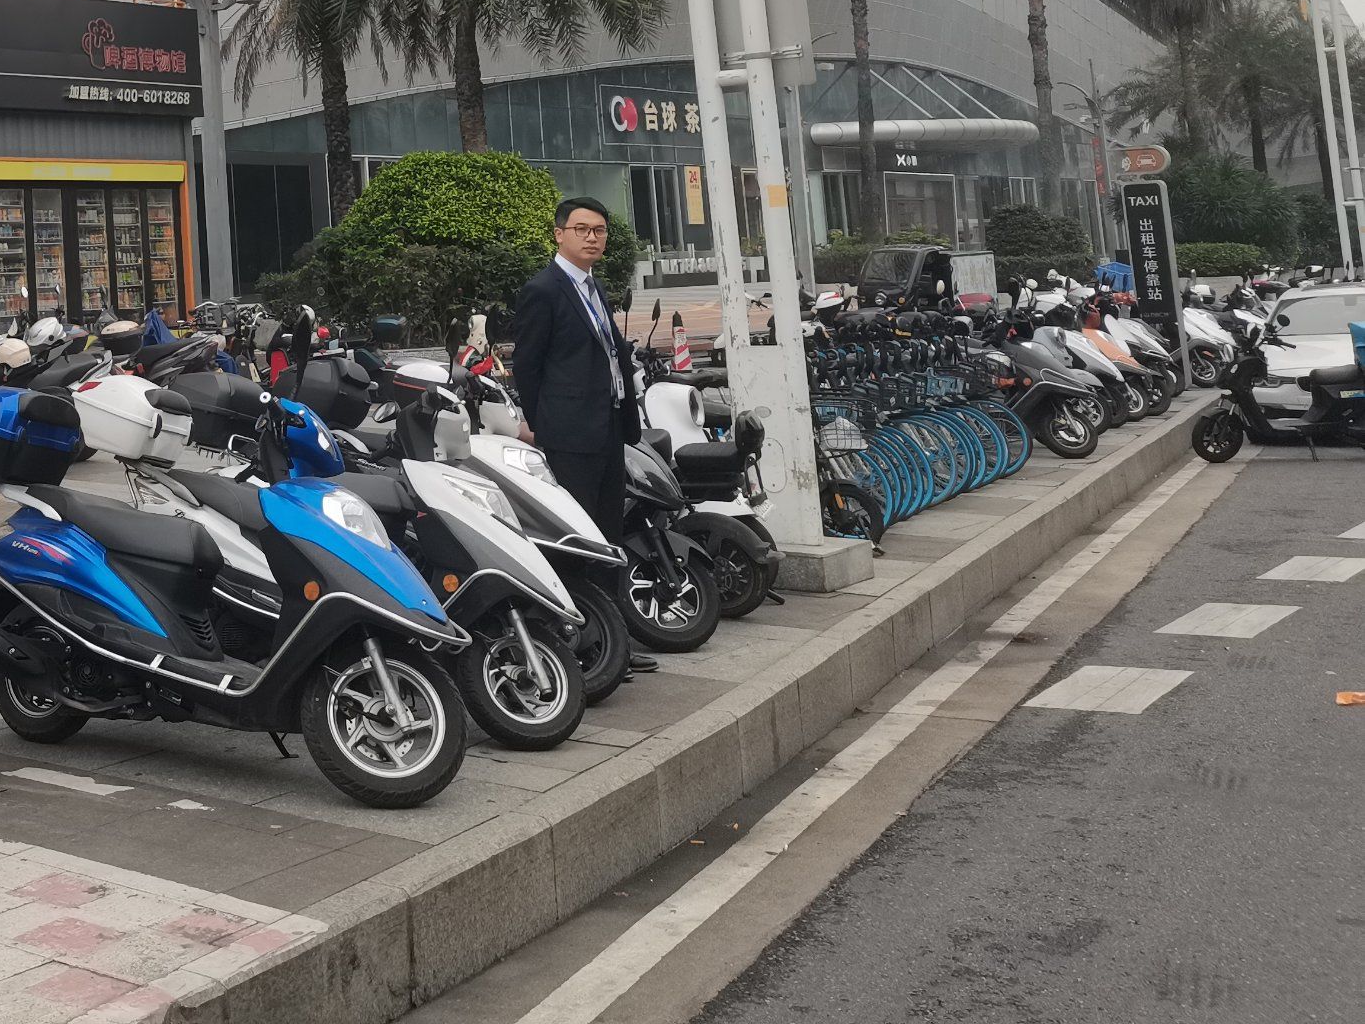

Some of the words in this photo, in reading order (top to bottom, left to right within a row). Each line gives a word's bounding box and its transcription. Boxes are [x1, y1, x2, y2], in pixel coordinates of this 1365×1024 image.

[116, 88, 191, 105] 400-6018268
[1127, 195, 1160, 208] TAXI
[1138, 218, 1164, 301] 出租车停靠站
